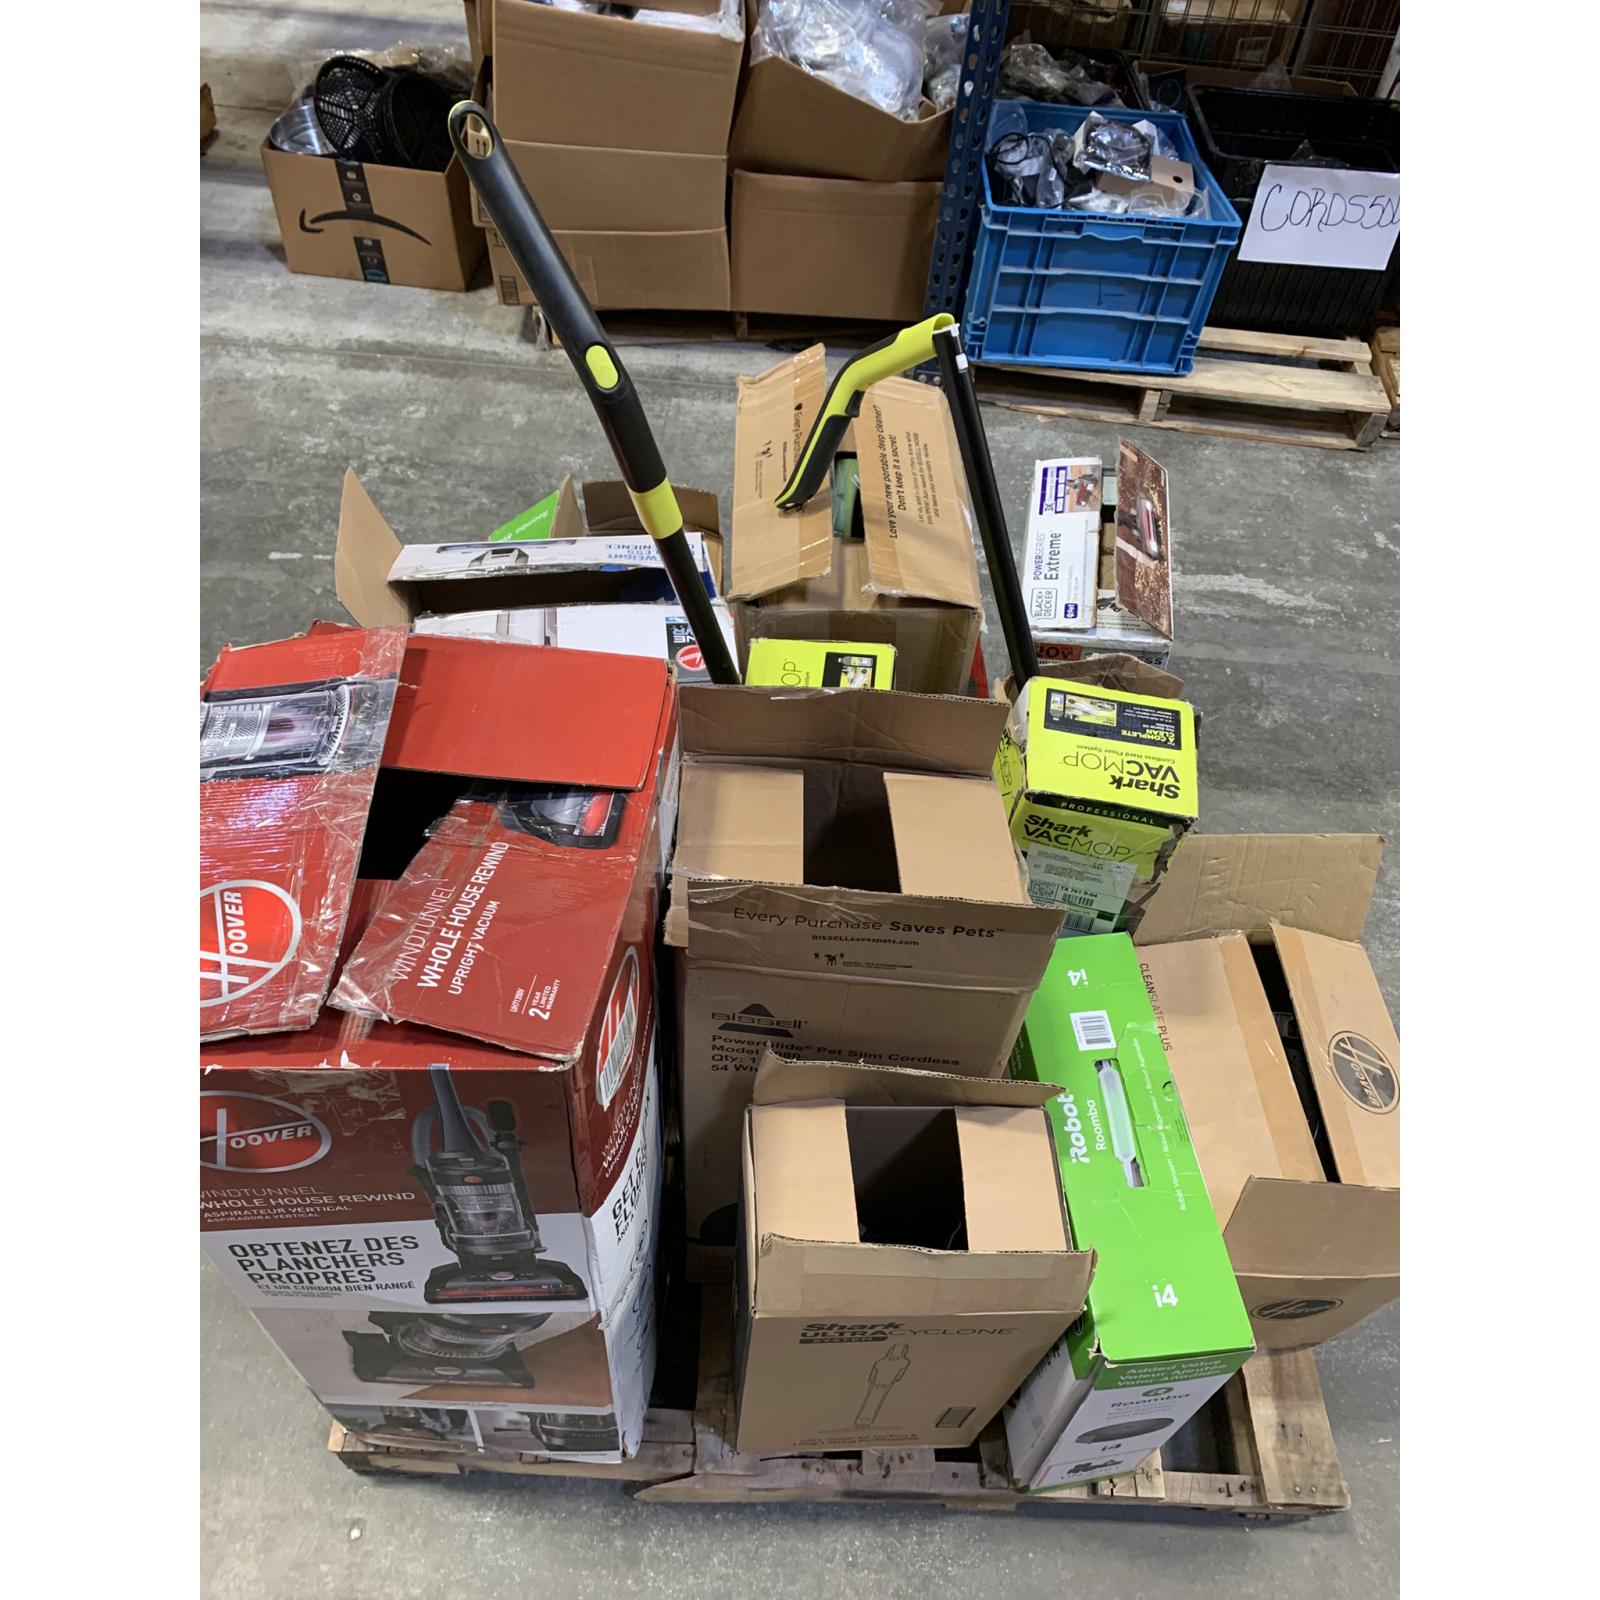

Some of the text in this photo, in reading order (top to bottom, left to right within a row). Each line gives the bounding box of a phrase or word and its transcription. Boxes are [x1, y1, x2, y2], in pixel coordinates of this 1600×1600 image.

[873, 405, 898, 539] Love your new portable deep cleaner?
[896, 472, 904, 490] keep
[897, 492, 906, 511] Don't
[1044, 532, 1062, 581] Extreme
[1043, 590, 1052, 617] DECKER
[1121, 729, 1168, 742] COMPLETE
[1063, 752, 1180, 783] VACMOP
[1109, 775, 1180, 799] Shark
[1061, 802, 1155, 825] PROFESSIONAL
[1024, 814, 1092, 838] Shark
[1023, 824, 1131, 858] VACMOP
[417, 841, 509, 987] WHOLE HOUSE REWIND
[734, 908, 788, 926] Every
[794, 915, 883, 931] Purchase
[889, 921, 946, 936] Saves
[392, 886, 456, 980] WINDTUNNEL
[448, 900, 500, 995] UPRIGHT VACUUM
[1067, 969, 1088, 986] i4
[532, 991, 542, 1006] YEAR
[538, 985, 551, 1008] LIMITED
[545, 978, 561, 1010] WARRANTY
[528, 1008, 550, 1020] 2
[712, 1044, 759, 1055] Model
[1157, 1025, 1172, 1052] PLUS
[711, 1053, 744, 1063] Qty:
[817, 1047, 842, 1056] Pet
[847, 1050, 882, 1060] Slim
[888, 1054, 960, 1065] Cordless
[711, 1064, 728, 1072] 54
[1057, 1093, 1090, 1164] iRobot
[1087, 1099, 1107, 1151] Roomba
[204, 1204, 351, 1218] ASPIRATEUR VERTICAL
[270, 1195, 335, 1207] HOUSE
[338, 1192, 416, 1203] REWIND
[228, 1235, 419, 1258] OBTENEZ DES
[236, 1252, 405, 1272] PLANCHERS
[247, 1269, 376, 1285] PROPRES
[345, 1283, 373, 1292] BIEN
[375, 1280, 415, 1291] RANGÉ
[1152, 1284, 1179, 1308] i4
[801, 1328, 1018, 1338] ULTRACYCLONE
[803, 1322, 905, 1331] Shark
[1127, 1360, 1222, 1374] Added Value
